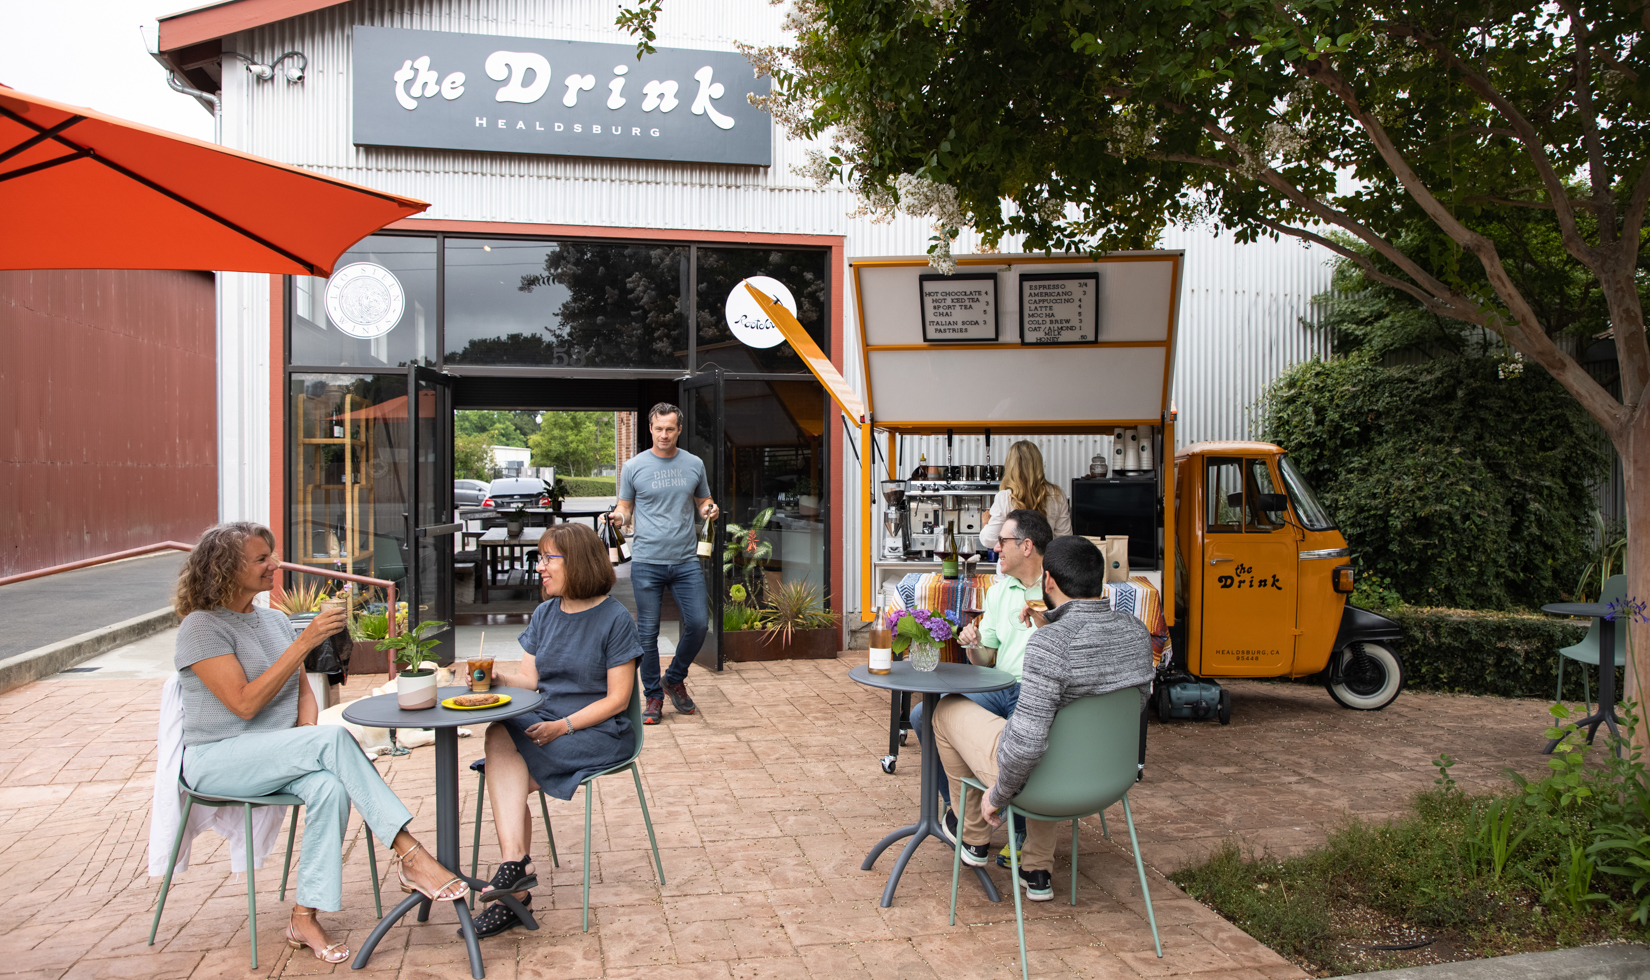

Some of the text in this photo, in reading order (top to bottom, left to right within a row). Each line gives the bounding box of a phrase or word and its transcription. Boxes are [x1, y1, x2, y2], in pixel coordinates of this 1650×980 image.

[394, 50, 736, 130] the Drink
[475, 116, 661, 137] HEALDSBURG
[330, 267, 401, 302] LEO STEEN
[338, 315, 392, 335] WINES
[552, 342, 587, 367] 53
[651, 478, 687, 489] CHENIN
[653, 469, 683, 480] DRINK
[1235, 563, 1253, 577] the
[1217, 574, 1283, 591] Drink
